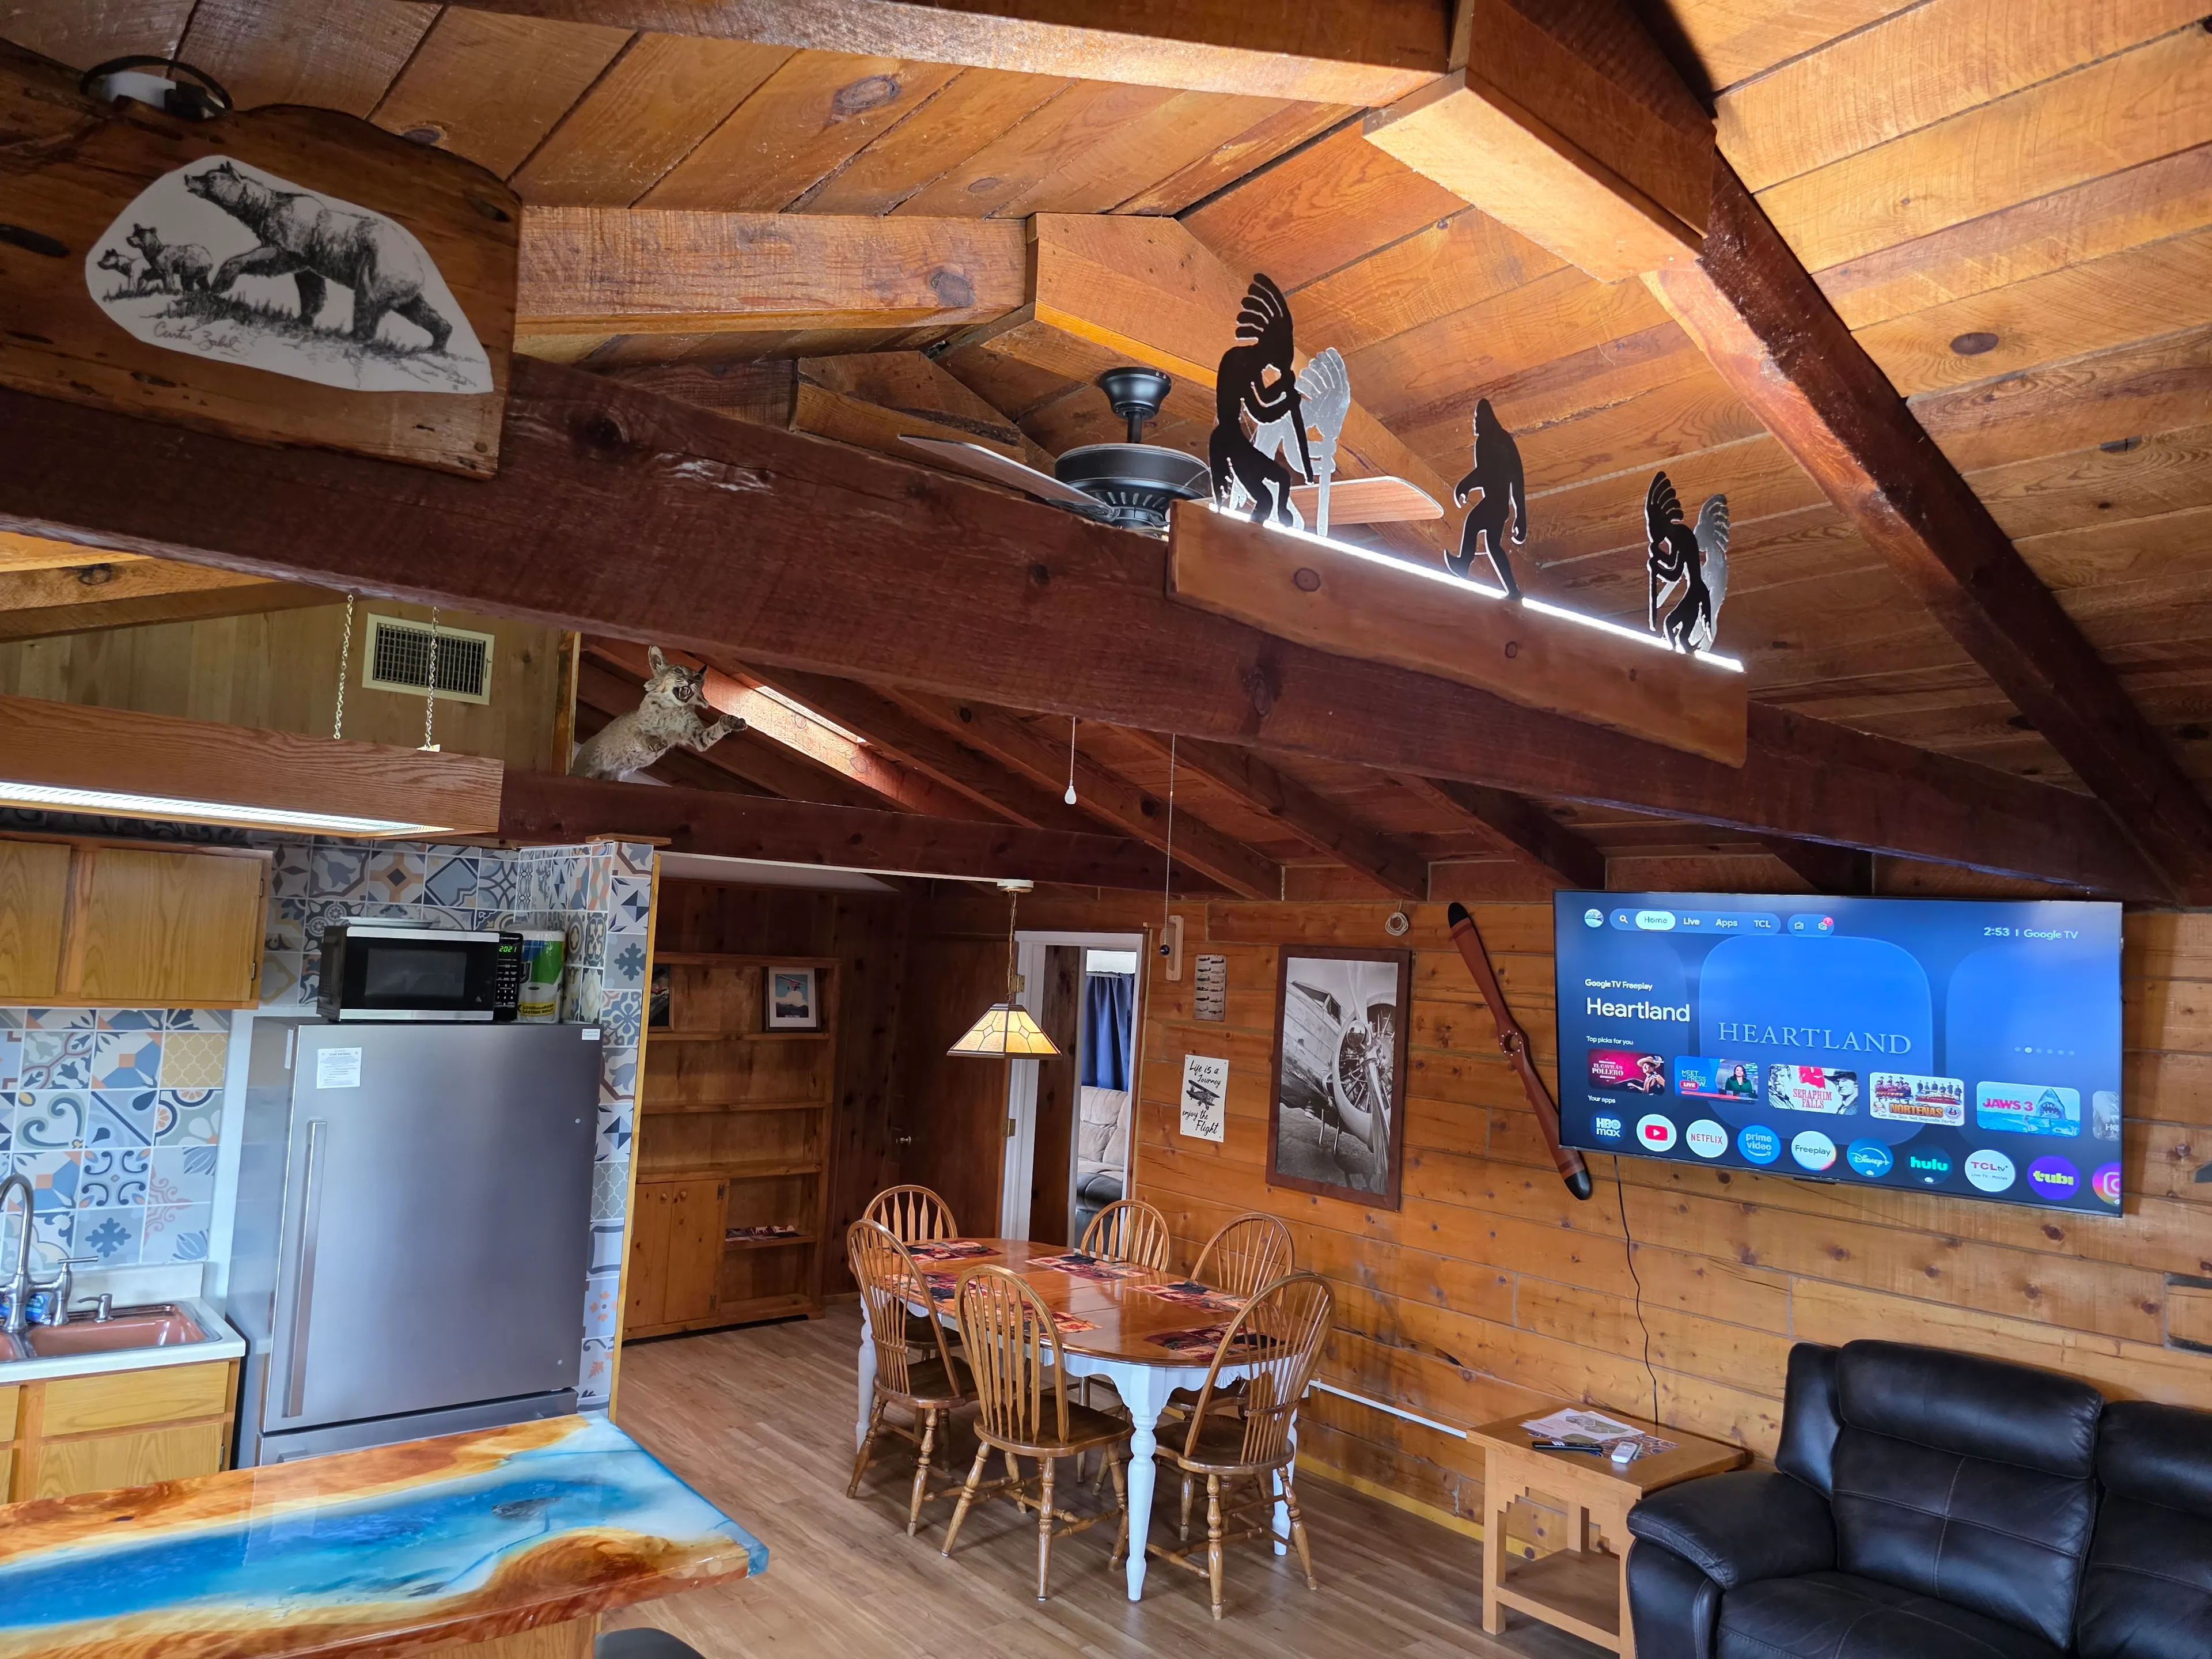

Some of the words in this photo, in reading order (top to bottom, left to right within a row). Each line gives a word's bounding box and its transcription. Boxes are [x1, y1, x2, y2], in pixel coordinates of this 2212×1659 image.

[1644, 916, 1668, 924] Home
[1683, 917, 1700, 926] Live
[1715, 918, 1738, 929] Apps
[1753, 919, 1771, 929] TCL
[1983, 927, 2010, 937] 2:53
[2023, 929, 2062, 940] Google
[2063, 931, 2078, 939] TV
[1584, 979, 1611, 989] Google
[1611, 980, 1621, 988] TV
[1622, 981, 1653, 991] Freeplay
[1586, 997, 1691, 1022] Heartland
[1718, 1022, 1912, 1054] HEARTLAND
[1189, 1059, 1202, 1075] Life
[1204, 1065, 1211, 1074] is
[1592, 1067, 1624, 1076] POLLERO
[1197, 1074, 1221, 1089] Journey
[1793, 1088, 1832, 1101] SERAPHIM
[1802, 1099, 1824, 1109] FALLS
[1982, 1097, 2021, 1111] JAWS
[2023, 1101, 2034, 1112] 3
[1182, 1109, 1198, 1120] enjoy
[1200, 1109, 1209, 1120] the
[1889, 1103, 1943, 1118] NORTEÑAS
[1195, 1120, 1219, 1136] Flight
[1596, 1118, 1621, 1128] HBO
[1596, 1127, 1620, 1138] max
[1745, 1132, 1772, 1142] prime
[1691, 1133, 1723, 1145] NETFLIX
[1747, 1141, 1772, 1151] video
[1795, 1145, 1831, 1157] Freeplay
[1910, 1156, 1948, 1171] hulu
[2033, 1170, 2074, 1185] tubi
